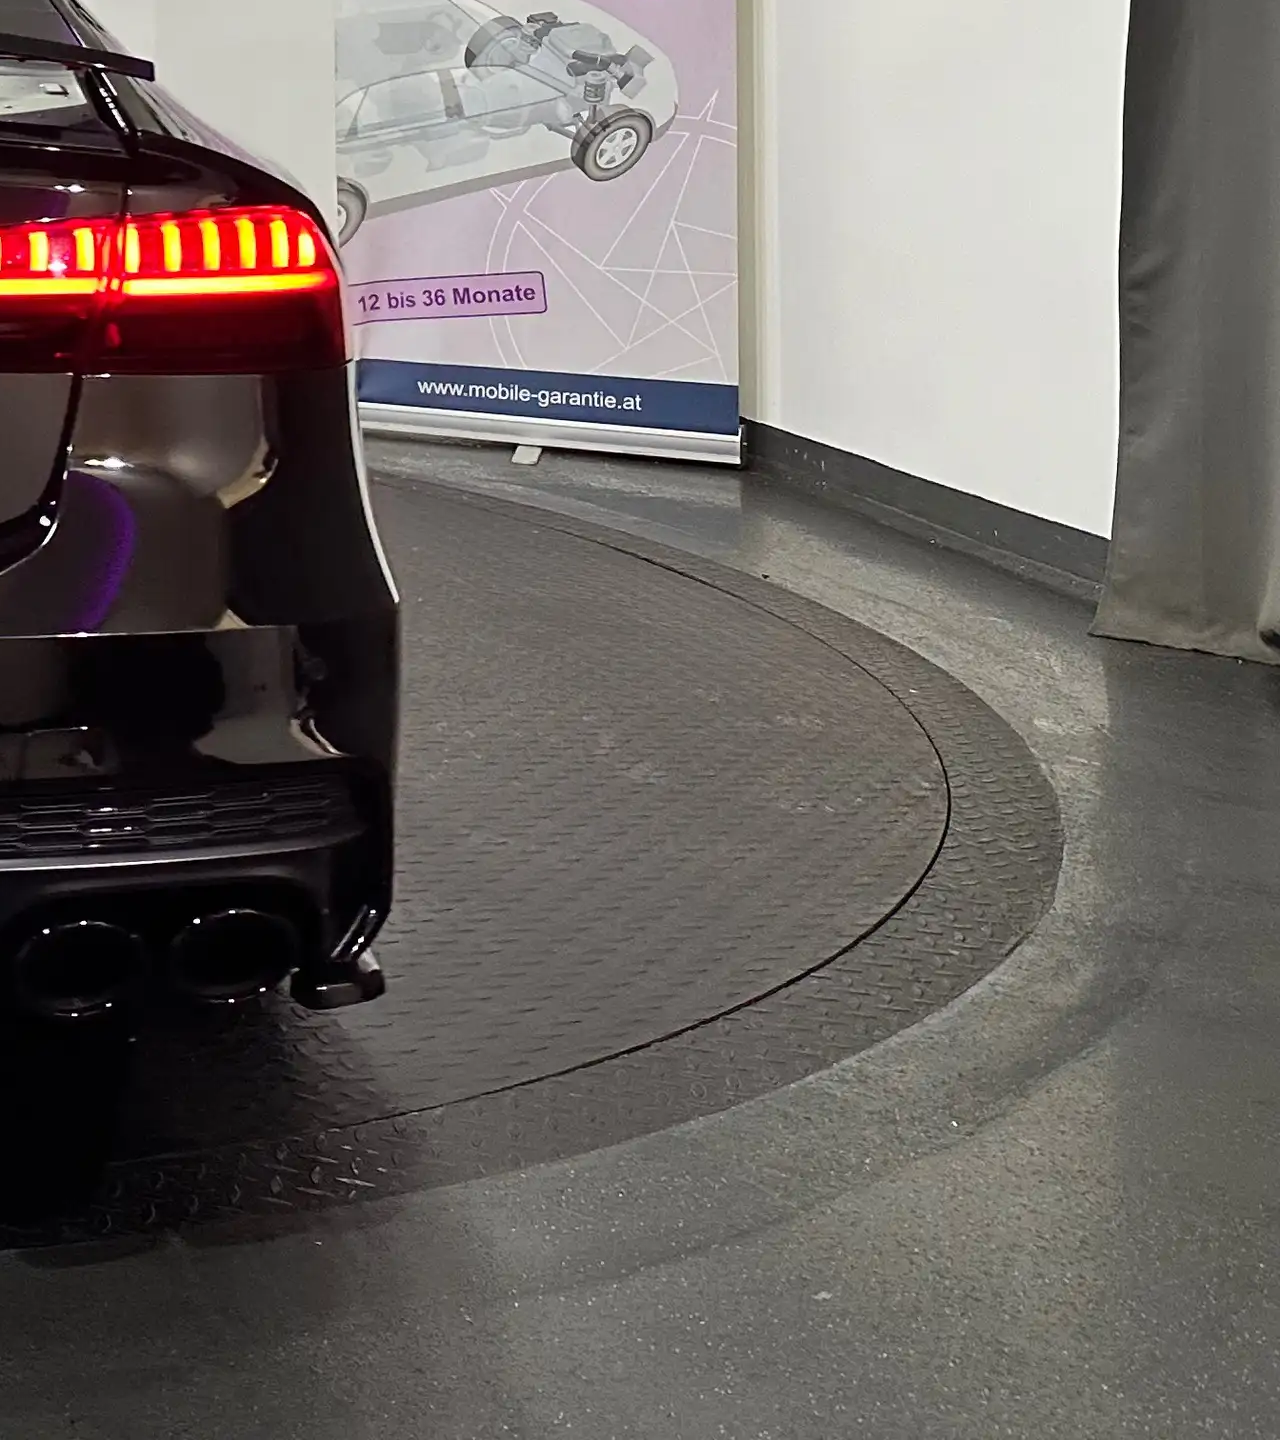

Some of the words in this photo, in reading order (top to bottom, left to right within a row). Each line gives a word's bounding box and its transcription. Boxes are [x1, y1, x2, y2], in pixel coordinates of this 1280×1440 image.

[358, 294, 380, 312] 12
[387, 292, 416, 310] bis
[423, 289, 445, 307] 36
[453, 284, 536, 305] Monate
[417, 380, 643, 411] www.mobile-garantie.at
